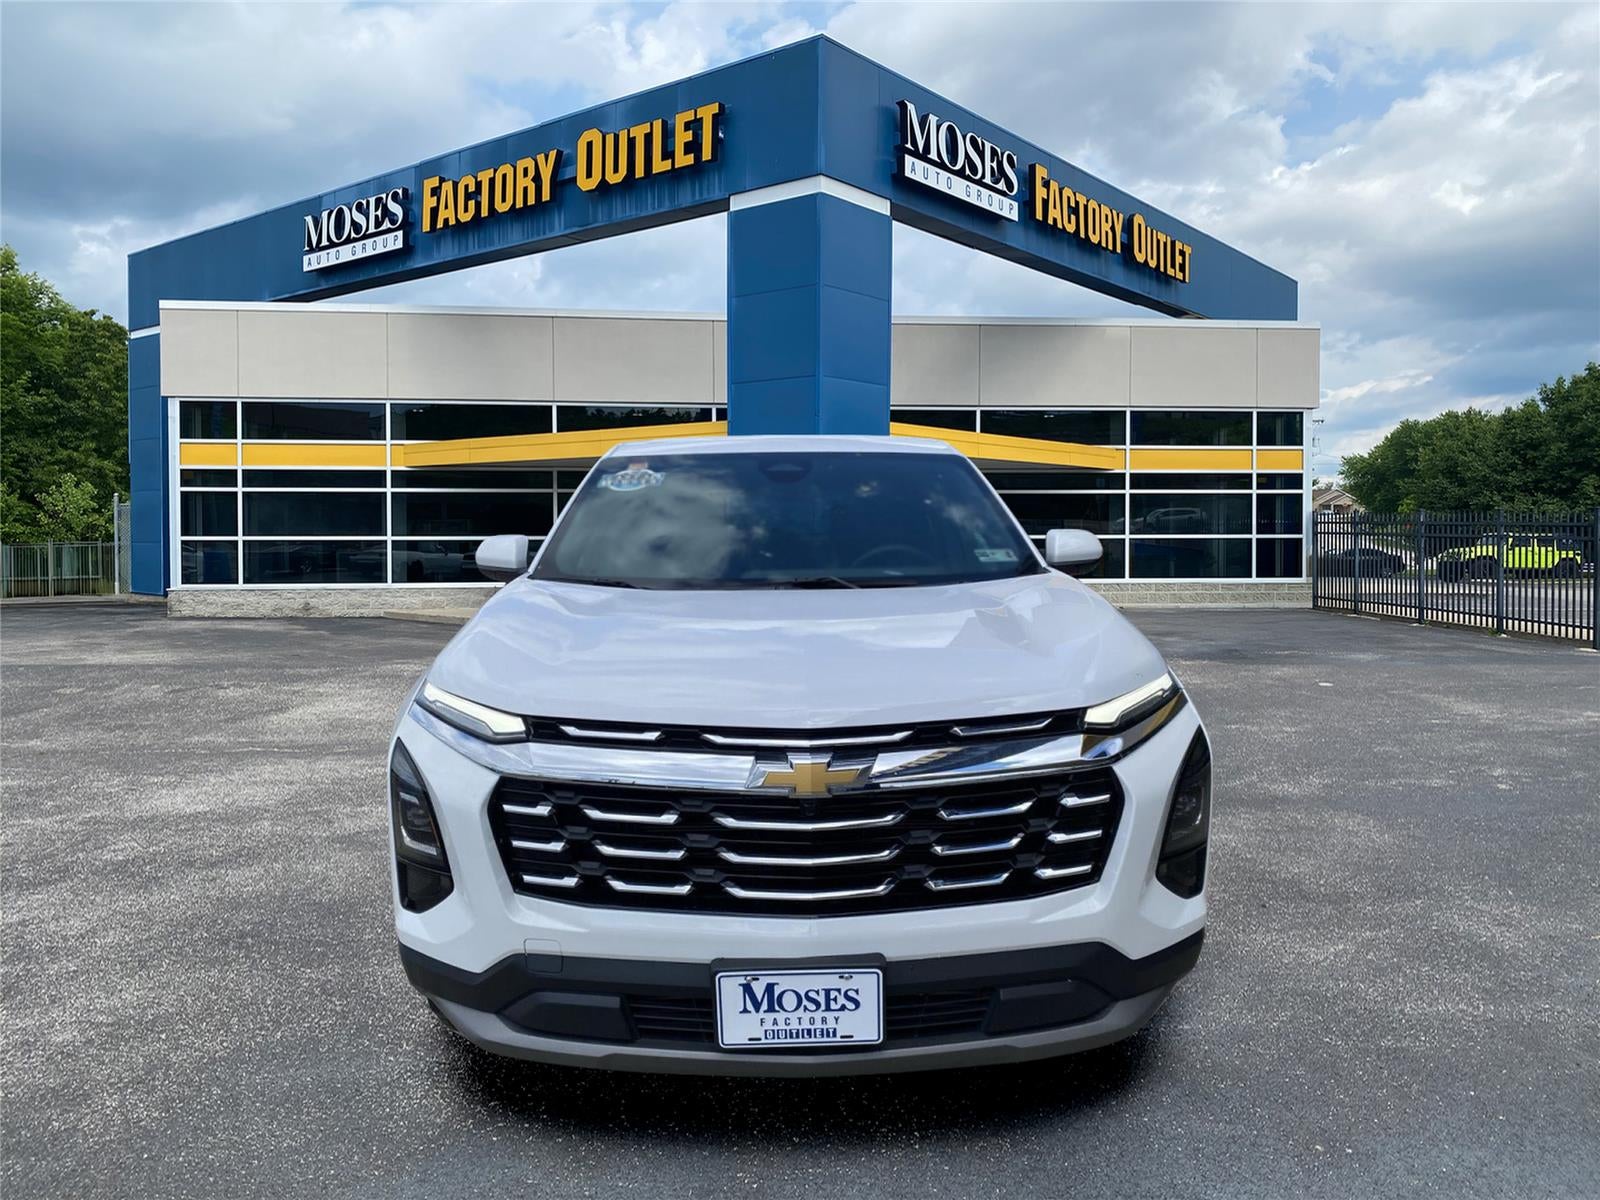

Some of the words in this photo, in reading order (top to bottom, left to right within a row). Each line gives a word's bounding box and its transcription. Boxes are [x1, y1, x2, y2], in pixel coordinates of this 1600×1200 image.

[421, 149, 559, 233] FACTORY
[576, 102, 720, 192] OUTLET
[904, 100, 1018, 196] MOSES
[910, 161, 953, 190] AUTO
[965, 185, 1014, 215] GROUP
[303, 187, 404, 252] MOSES
[1035, 163, 1124, 253] FACTORY
[1132, 213, 1192, 283] OUTLET
[307, 248, 340, 269] AUTO
[351, 234, 399, 256] GROUP
[738, 982, 861, 1014] MOSES
[760, 1016, 840, 1027] FACTORY
[765, 1028, 837, 1040] OUTLET
